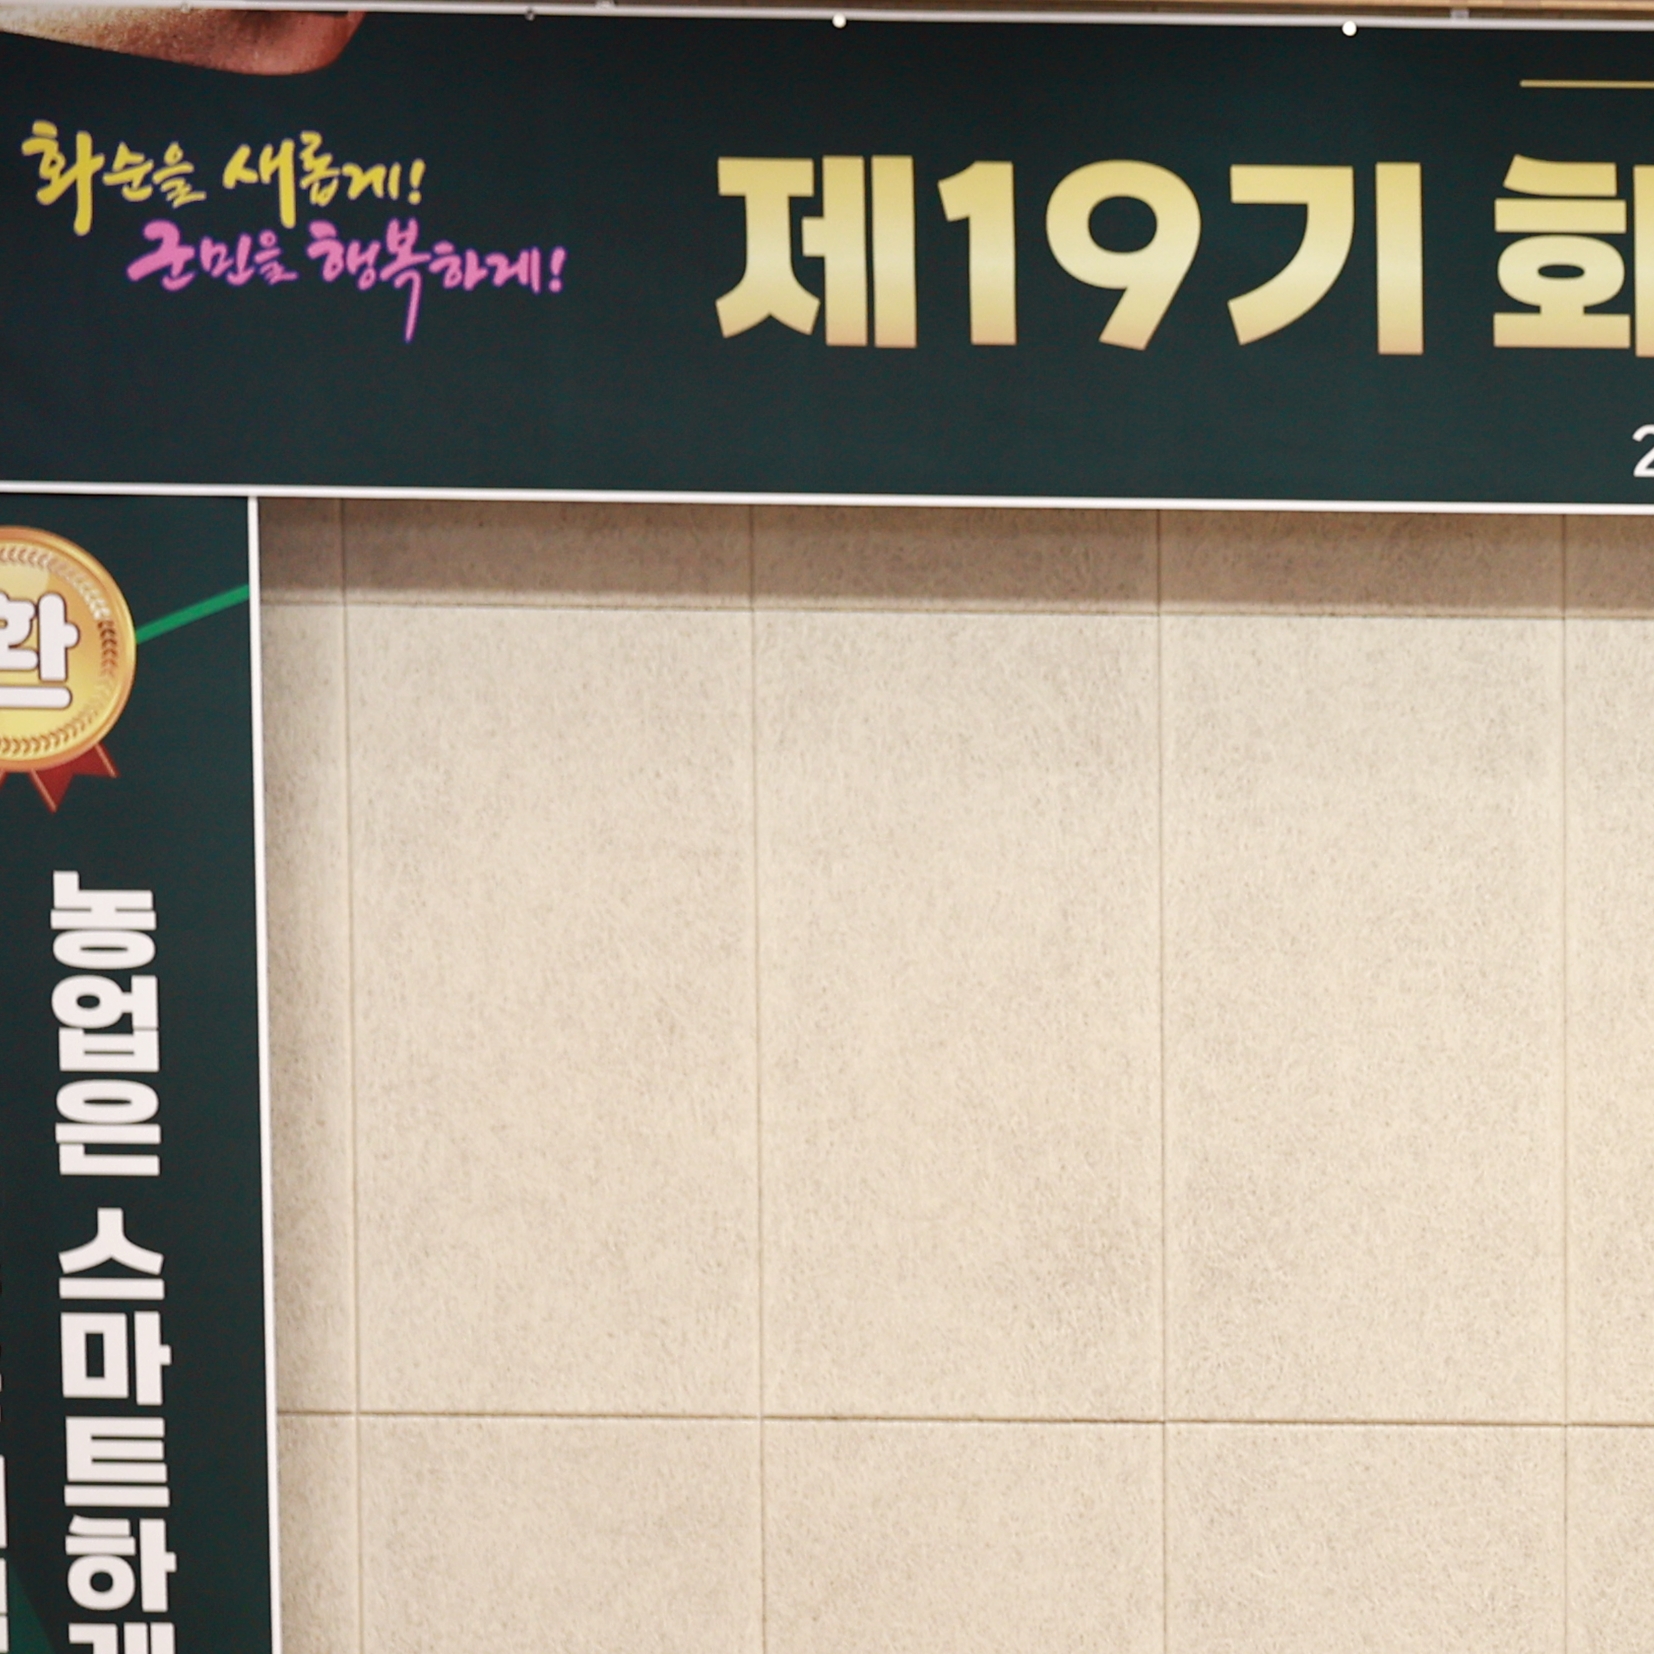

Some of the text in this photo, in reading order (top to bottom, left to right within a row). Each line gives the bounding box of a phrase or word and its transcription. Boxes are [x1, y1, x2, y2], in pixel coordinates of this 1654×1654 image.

[21, 121, 426, 236] 화순을 새롭게!
[715, 155, 1424, 355] 제19기
[127, 218, 566, 342] 군민을 행복하게!
[50, 871, 161, 1176] 농업은
